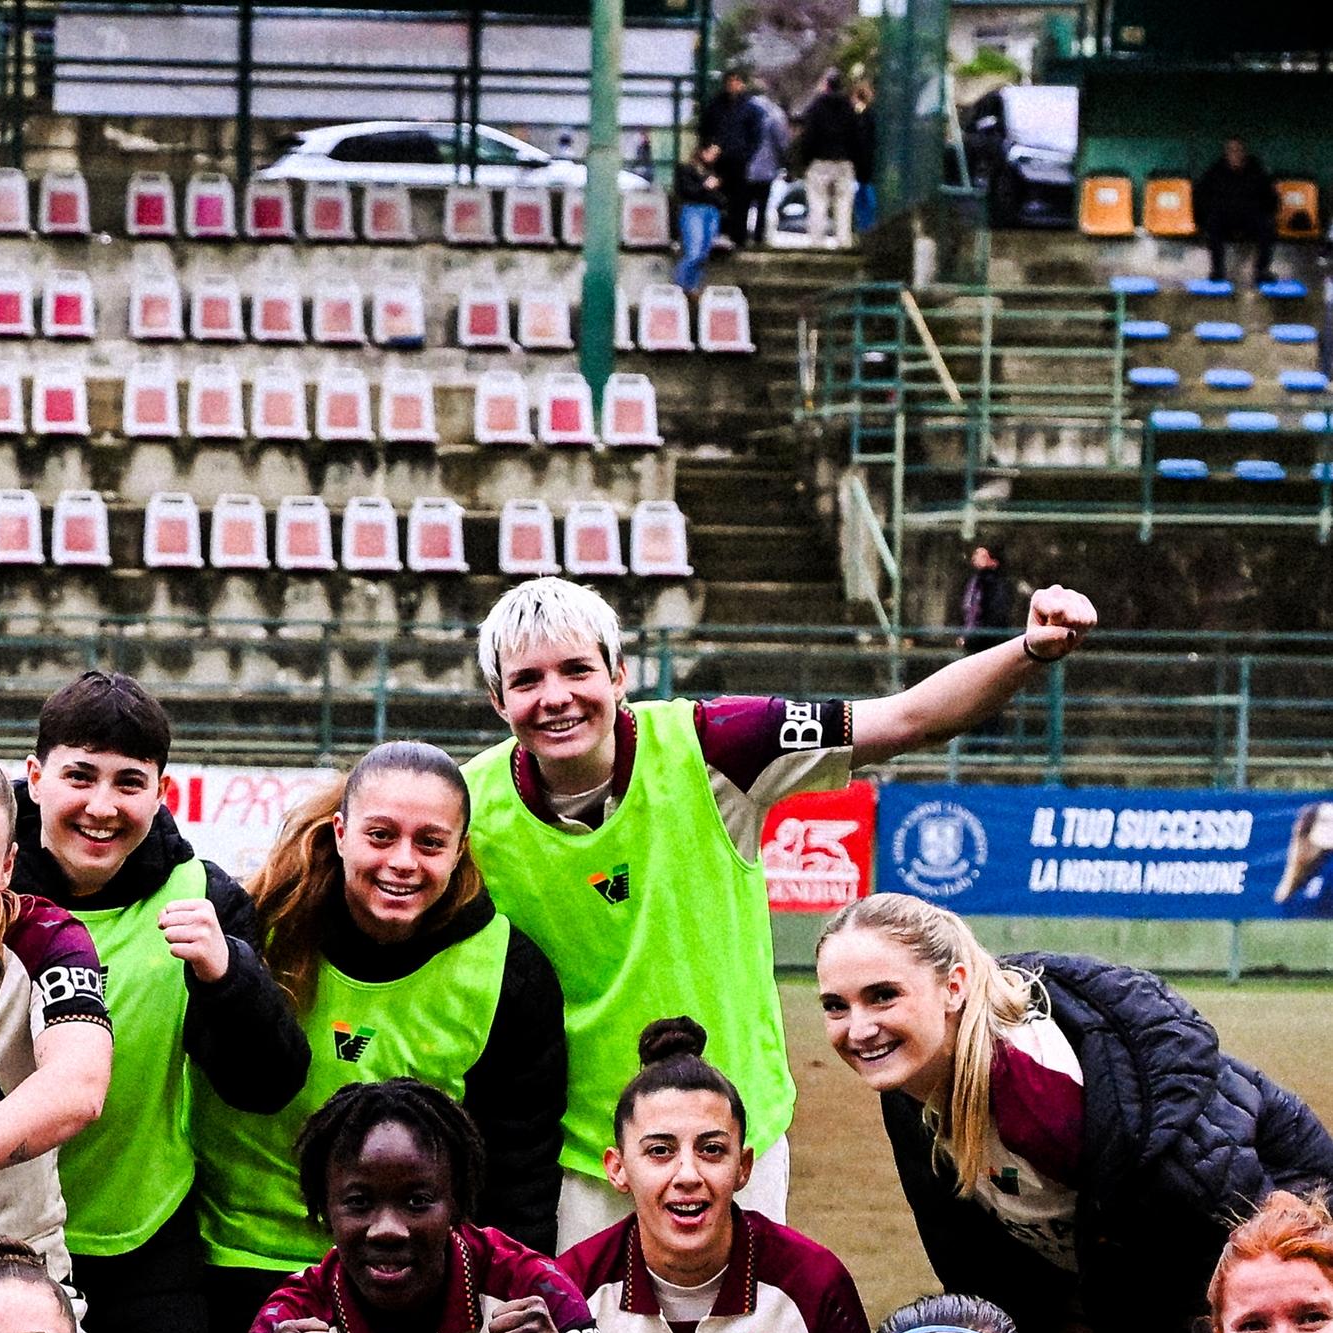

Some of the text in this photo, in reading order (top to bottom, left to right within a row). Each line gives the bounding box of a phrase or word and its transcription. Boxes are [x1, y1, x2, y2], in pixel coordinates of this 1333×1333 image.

[1062, 807, 1115, 848] TUO
[1114, 809, 1253, 849] SUCCESSO
[1058, 859, 1142, 894] NOSTRA
[1142, 860, 1248, 894] MISSIONE
